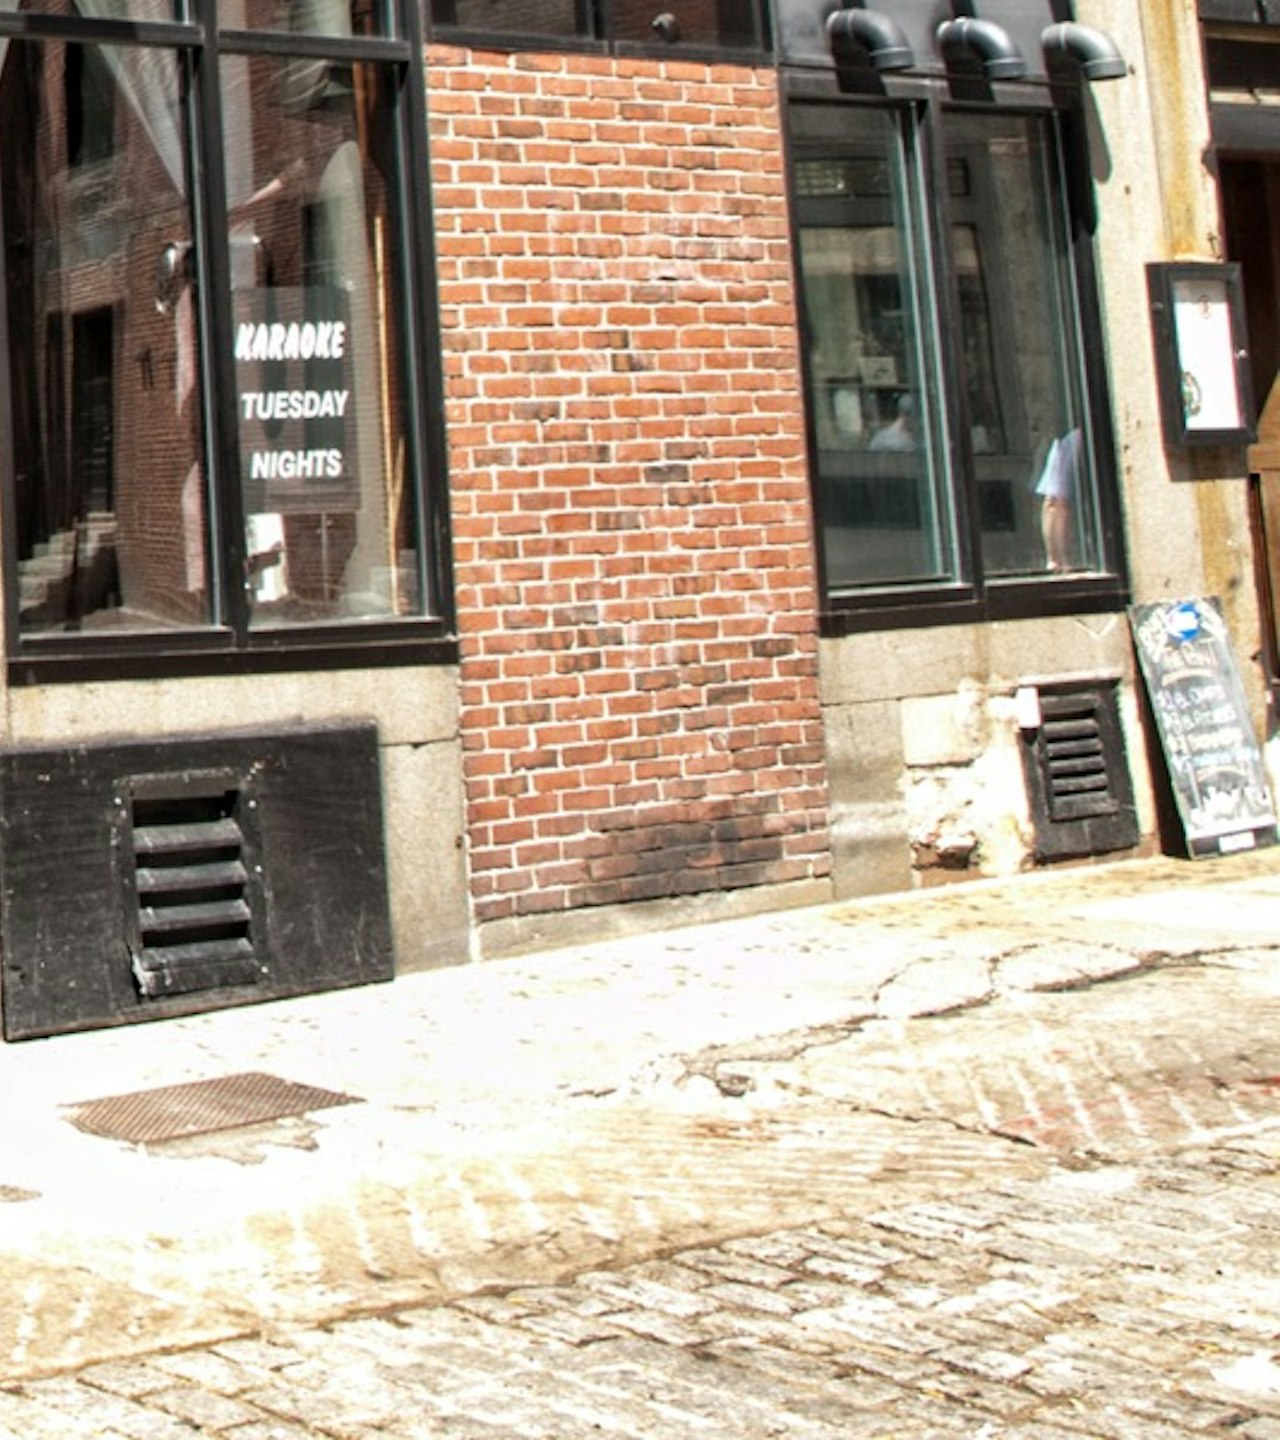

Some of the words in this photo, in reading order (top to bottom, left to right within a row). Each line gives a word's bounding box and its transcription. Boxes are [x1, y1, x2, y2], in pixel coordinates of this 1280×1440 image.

[235, 321, 346, 360] KARAOKE
[242, 390, 349, 420] TUESDAY
[251, 449, 342, 479] NIGHTS
